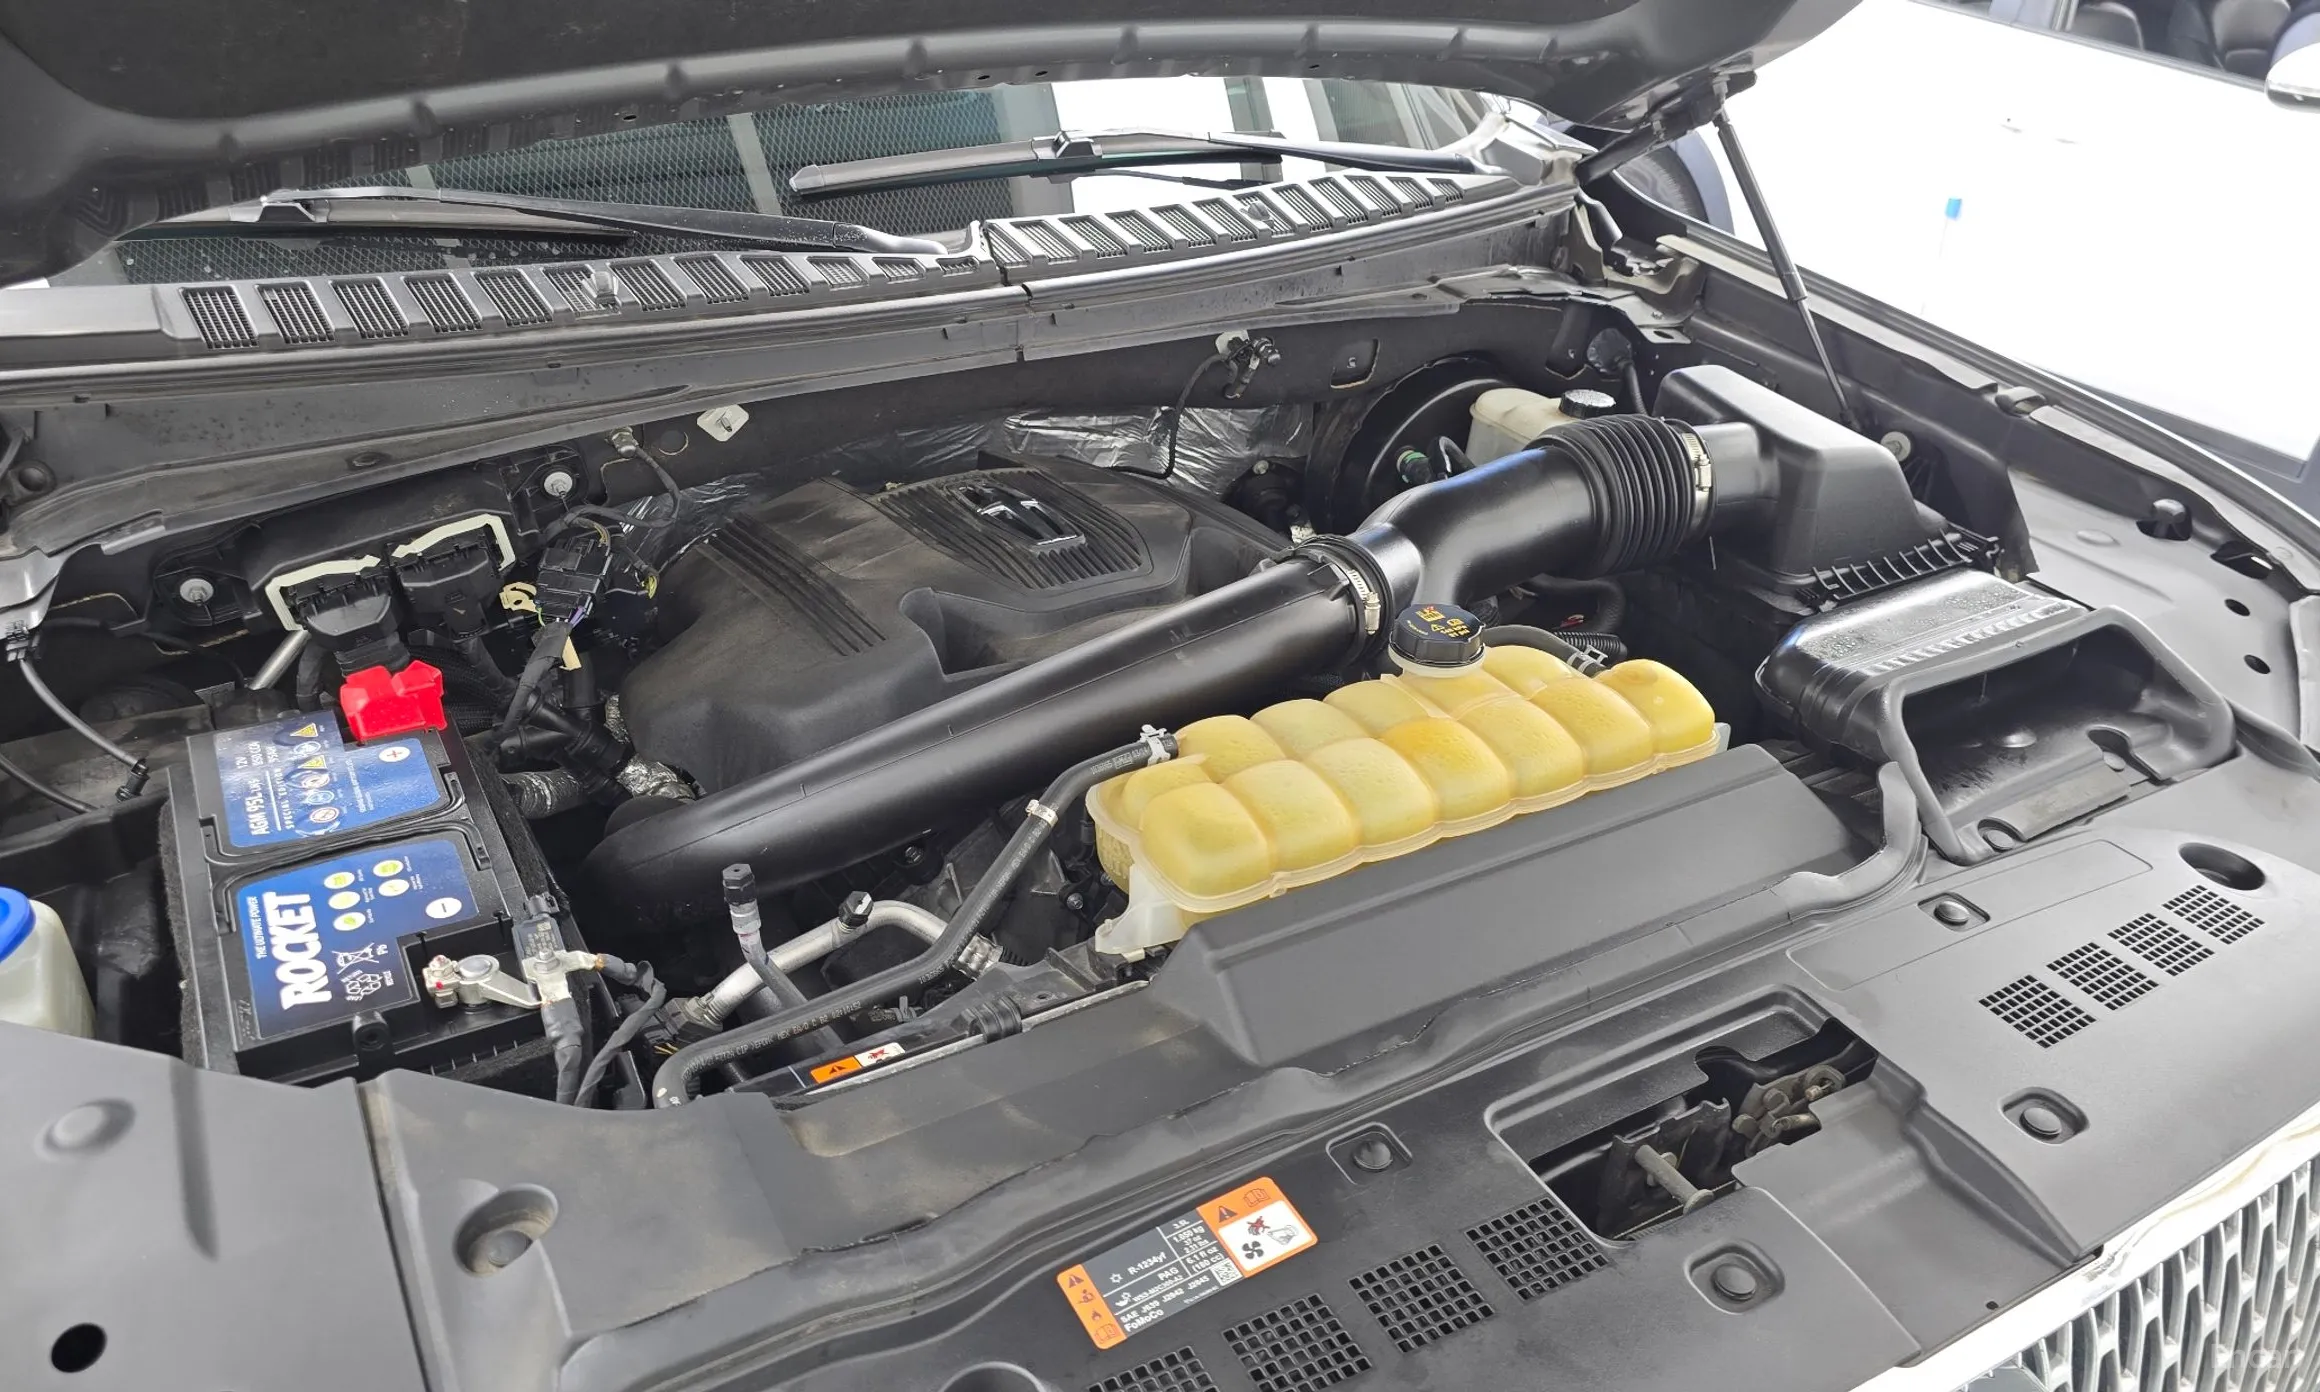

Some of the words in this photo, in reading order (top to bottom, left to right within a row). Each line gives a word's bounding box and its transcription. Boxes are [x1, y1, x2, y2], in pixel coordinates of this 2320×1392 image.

[236, 756, 248, 769] 12V
[273, 767, 288, 799] EDITION
[245, 796, 265, 812] 95L
[248, 811, 270, 835] AGM
[281, 799, 295, 830] SPECIAL
[246, 896, 260, 917] POWER
[250, 917, 265, 945] ULTIMATE
[254, 945, 267, 959] THE
[262, 891, 333, 1011] ROCKET
[1192, 1226, 1205, 1235] kg
[1127, 1251, 1167, 1275] R-1234yf
[1186, 1254, 1199, 1264] 6.1
[1199, 1250, 1208, 1259] fl
[1207, 1246, 1219, 1254] oz
[1210, 1252, 1225, 1263] cc)
[1157, 1267, 1179, 1281] PAG
[1120, 1310, 1140, 1323] SAE
[1124, 1309, 1164, 1332] FoMoCo
